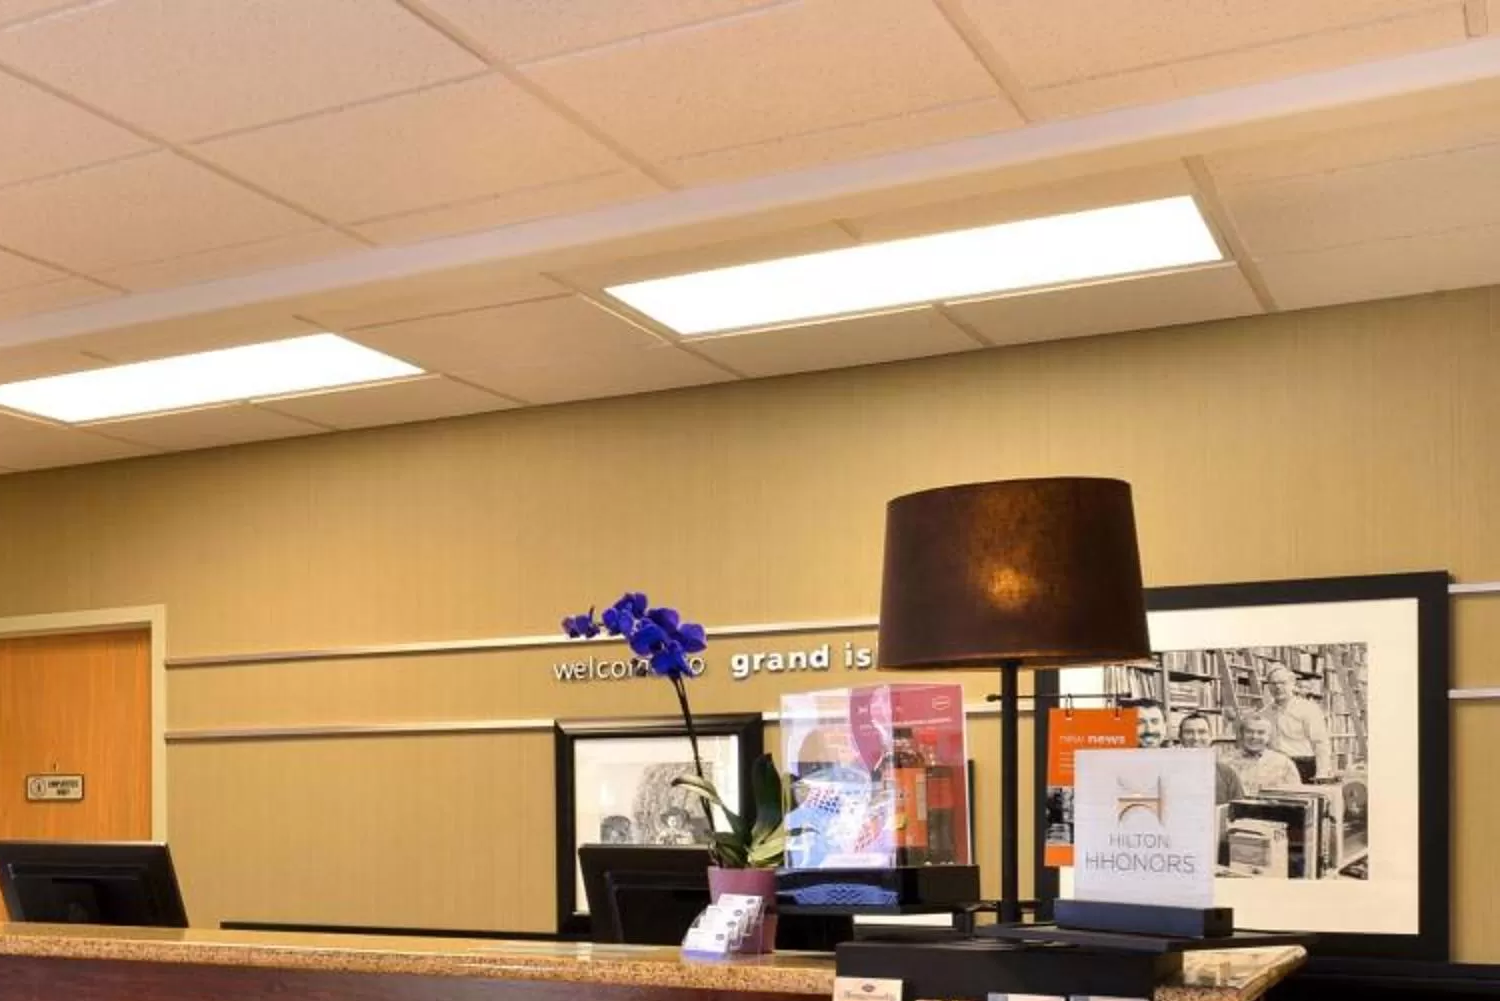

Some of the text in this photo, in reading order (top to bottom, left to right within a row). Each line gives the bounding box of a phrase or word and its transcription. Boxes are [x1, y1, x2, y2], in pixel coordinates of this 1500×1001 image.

[553, 656, 651, 680] welcom
[731, 643, 830, 679] grand
[844, 641, 879, 668] is
[1087, 735, 1126, 746] news
[1108, 833, 1171, 849] HILTON
[1084, 852, 1197, 874] HHONORS
